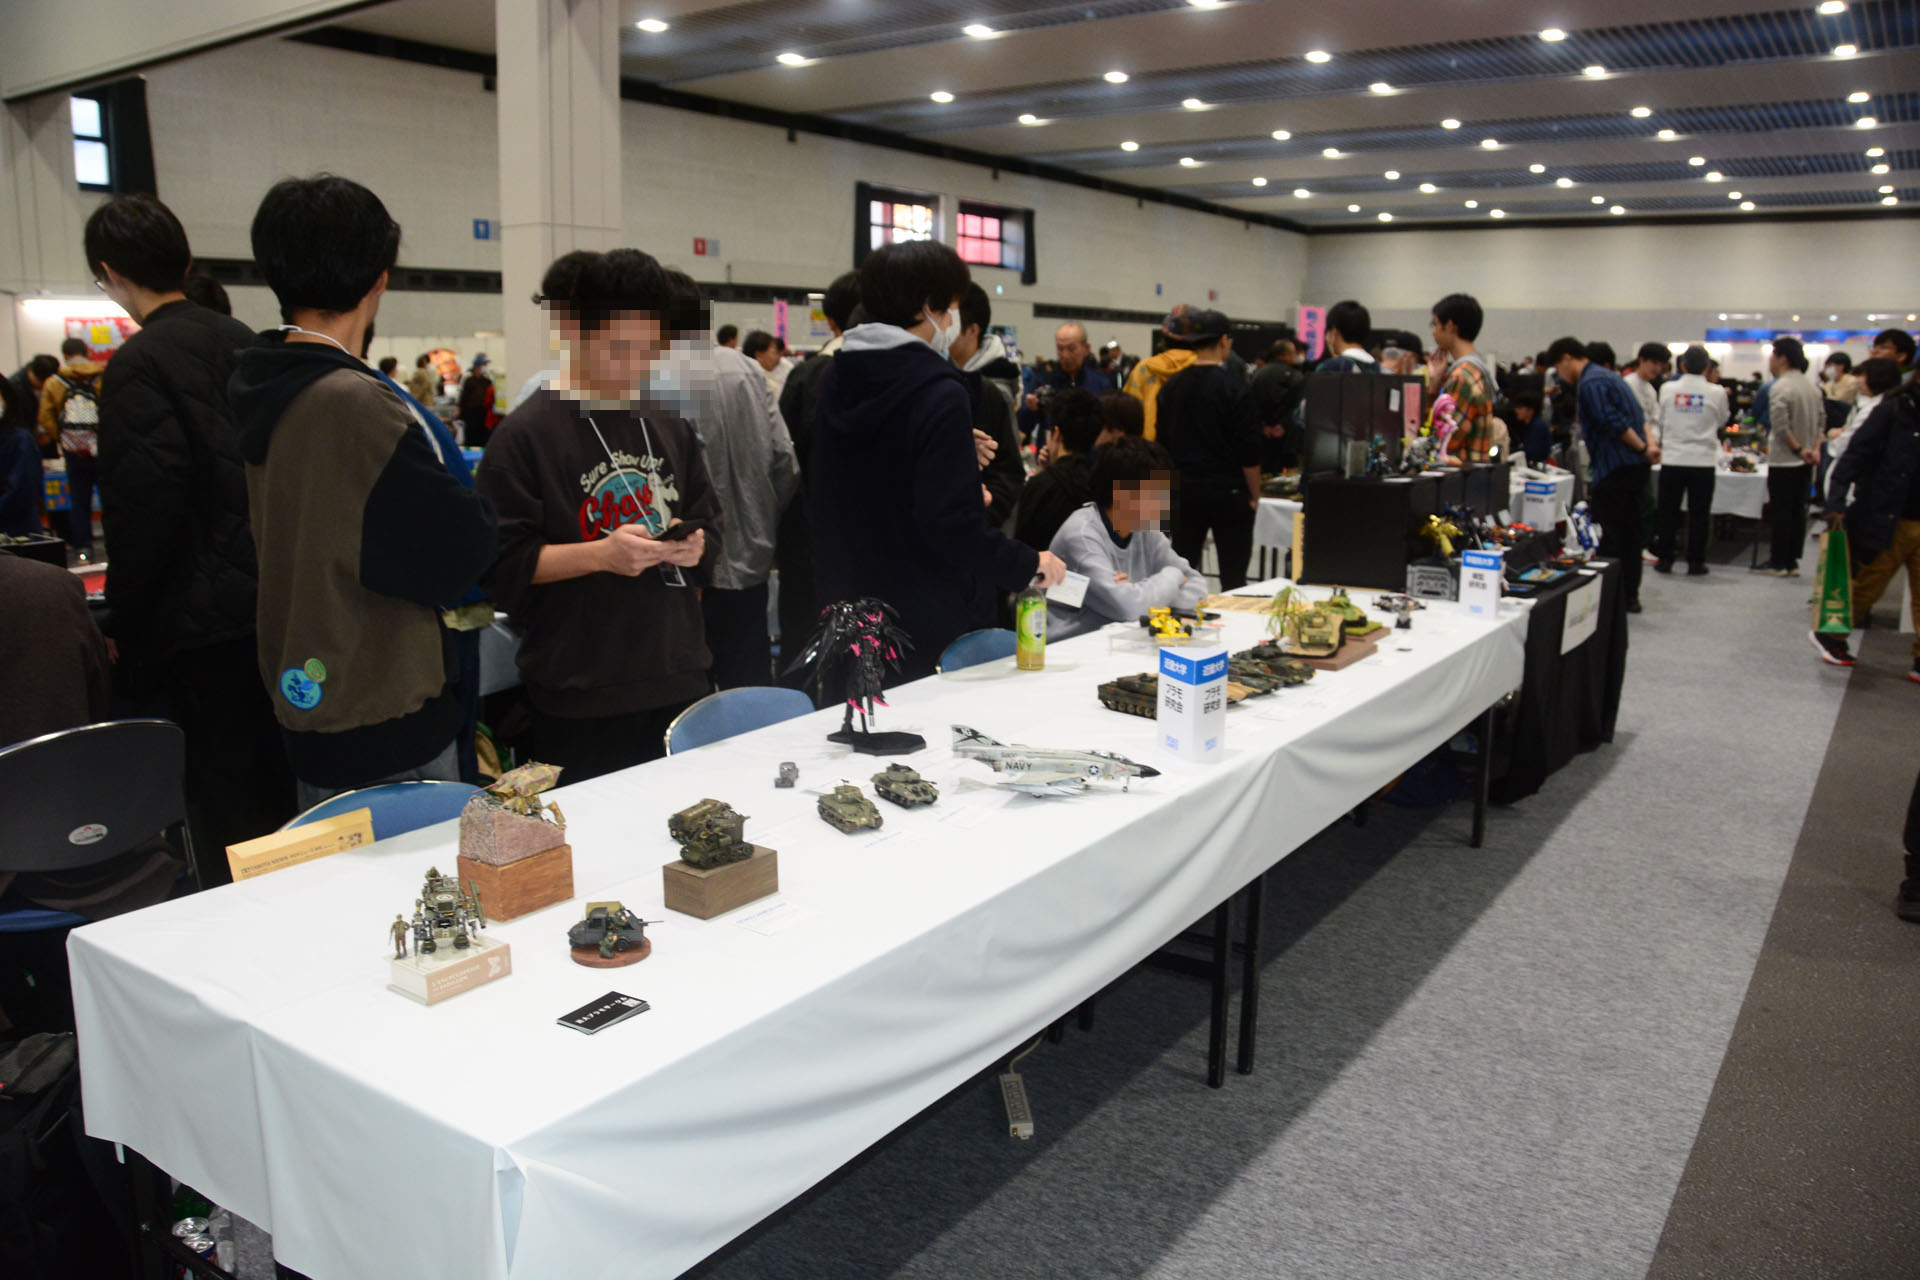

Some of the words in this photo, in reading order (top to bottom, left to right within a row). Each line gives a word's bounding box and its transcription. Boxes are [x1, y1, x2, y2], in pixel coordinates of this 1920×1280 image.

[580, 461, 607, 493] Sure
[611, 449, 640, 469] Show
[640, 454, 664, 472] Up!
[1166, 683, 1183, 700] プラモ
[1005, 761, 1032, 772] NAVY
